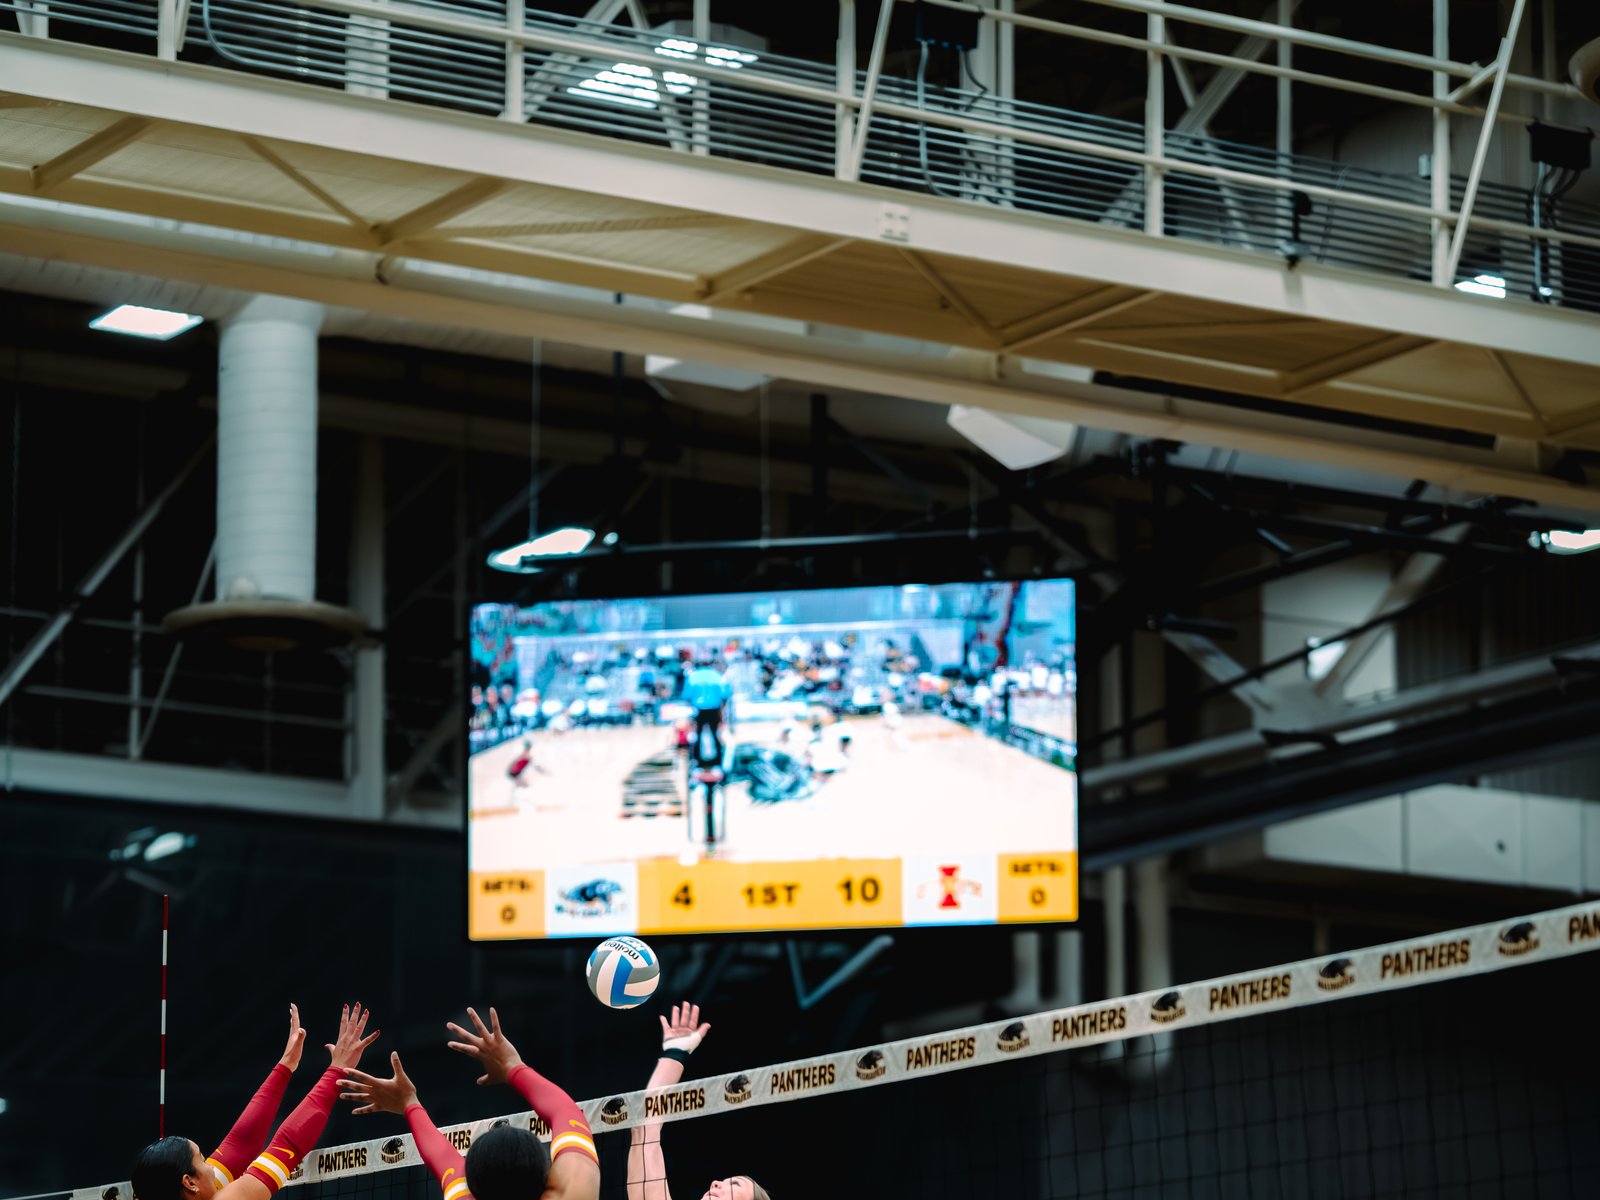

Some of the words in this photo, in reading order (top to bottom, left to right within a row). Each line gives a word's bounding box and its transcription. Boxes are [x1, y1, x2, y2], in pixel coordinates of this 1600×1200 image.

[674, 883, 694, 907] 4
[744, 883, 798, 906] 1ST
[840, 878, 881, 904] 10
[604, 941, 640, 960] molten
[1381, 939, 1471, 979] PANTHERS
[1209, 974, 1292, 1012] PANTHERS
[1052, 1006, 1127, 1043] PANTHERS
[906, 1036, 976, 1071] PANTHERS
[770, 1063, 836, 1095] PANTHERS
[644, 1088, 706, 1118] PANTHERS
[318, 1147, 367, 1174] PANTHERS
